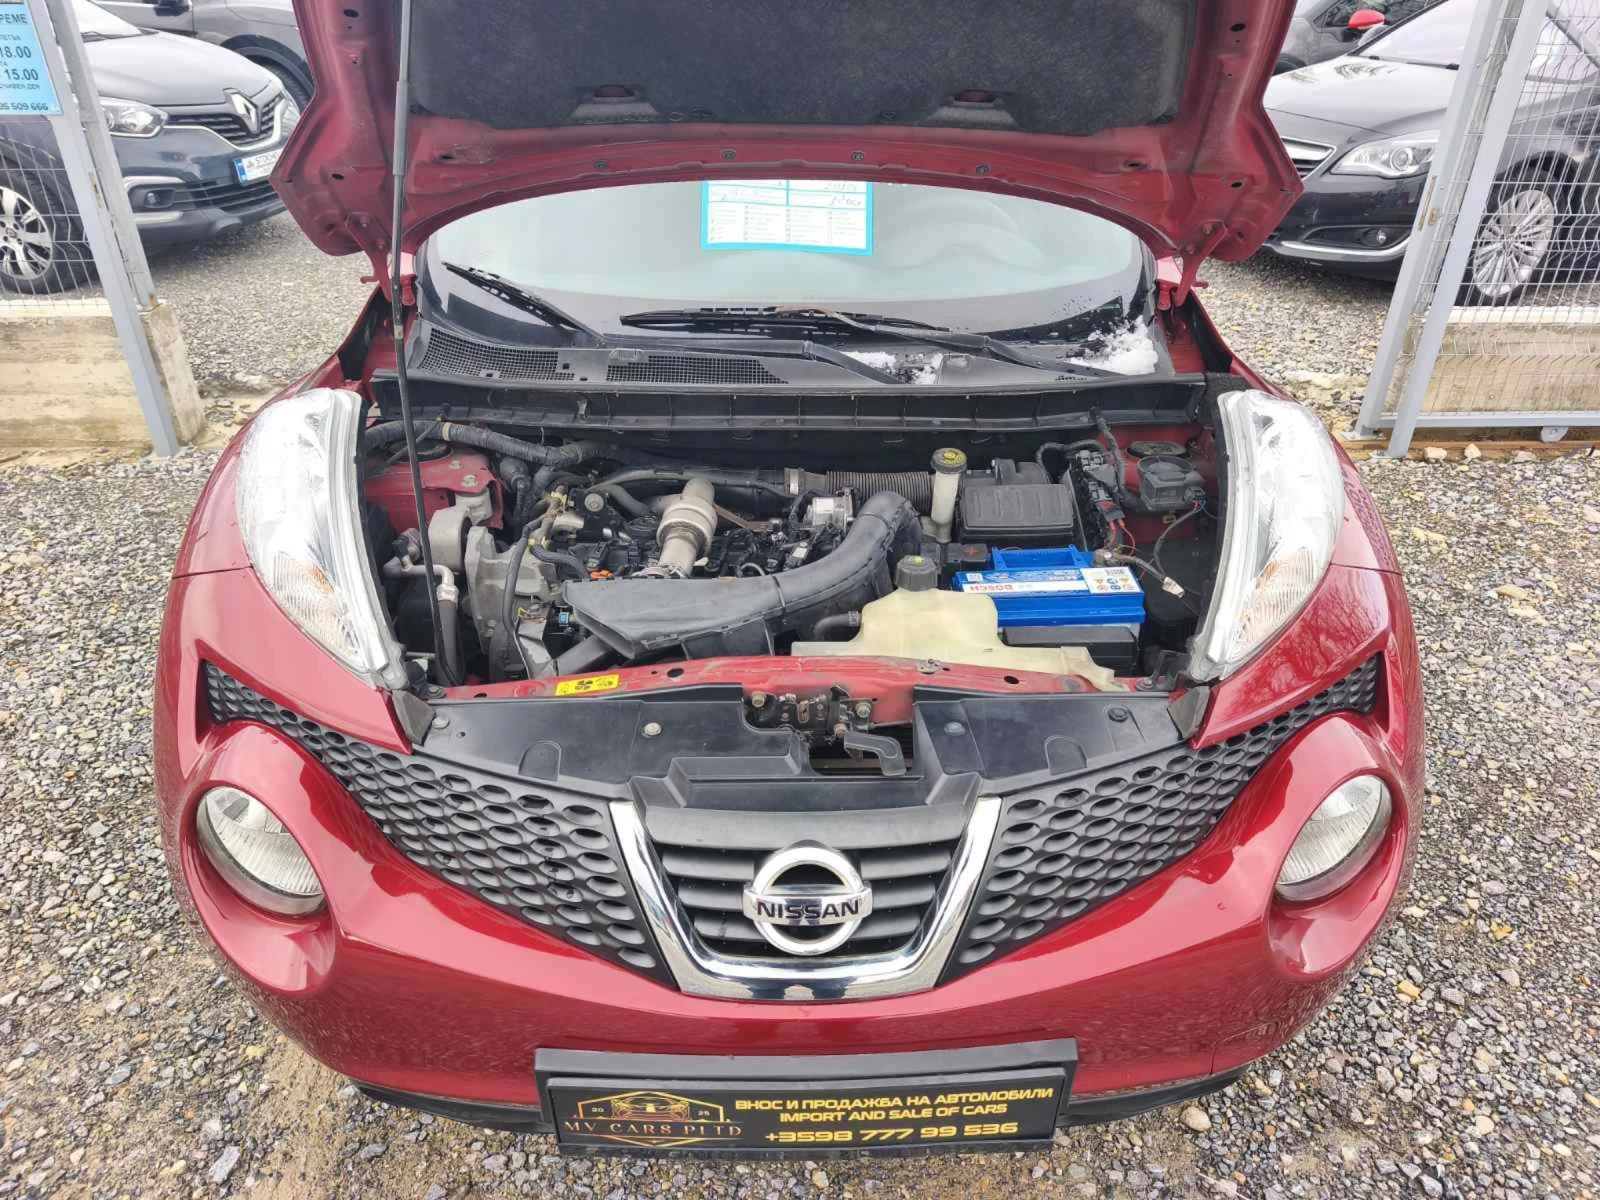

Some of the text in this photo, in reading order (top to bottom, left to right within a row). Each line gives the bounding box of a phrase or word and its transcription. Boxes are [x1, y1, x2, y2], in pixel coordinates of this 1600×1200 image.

[4, 68, 39, 81] 15.00
[11, 102, 29, 111] 509
[31, 102, 48, 111] 666
[756, 899, 860, 919] NISSAN
[735, 1087, 1054, 1111] ВНОС И ПРОДАЖБА НА АВТОМОБИЛИ
[780, 1103, 1008, 1123] IMPORT AND SALE OF CARS
[564, 1121, 597, 1132] MV
[609, 1123, 672, 1135] CARS
[765, 1122, 1019, 1143] +3598 777 99 536
